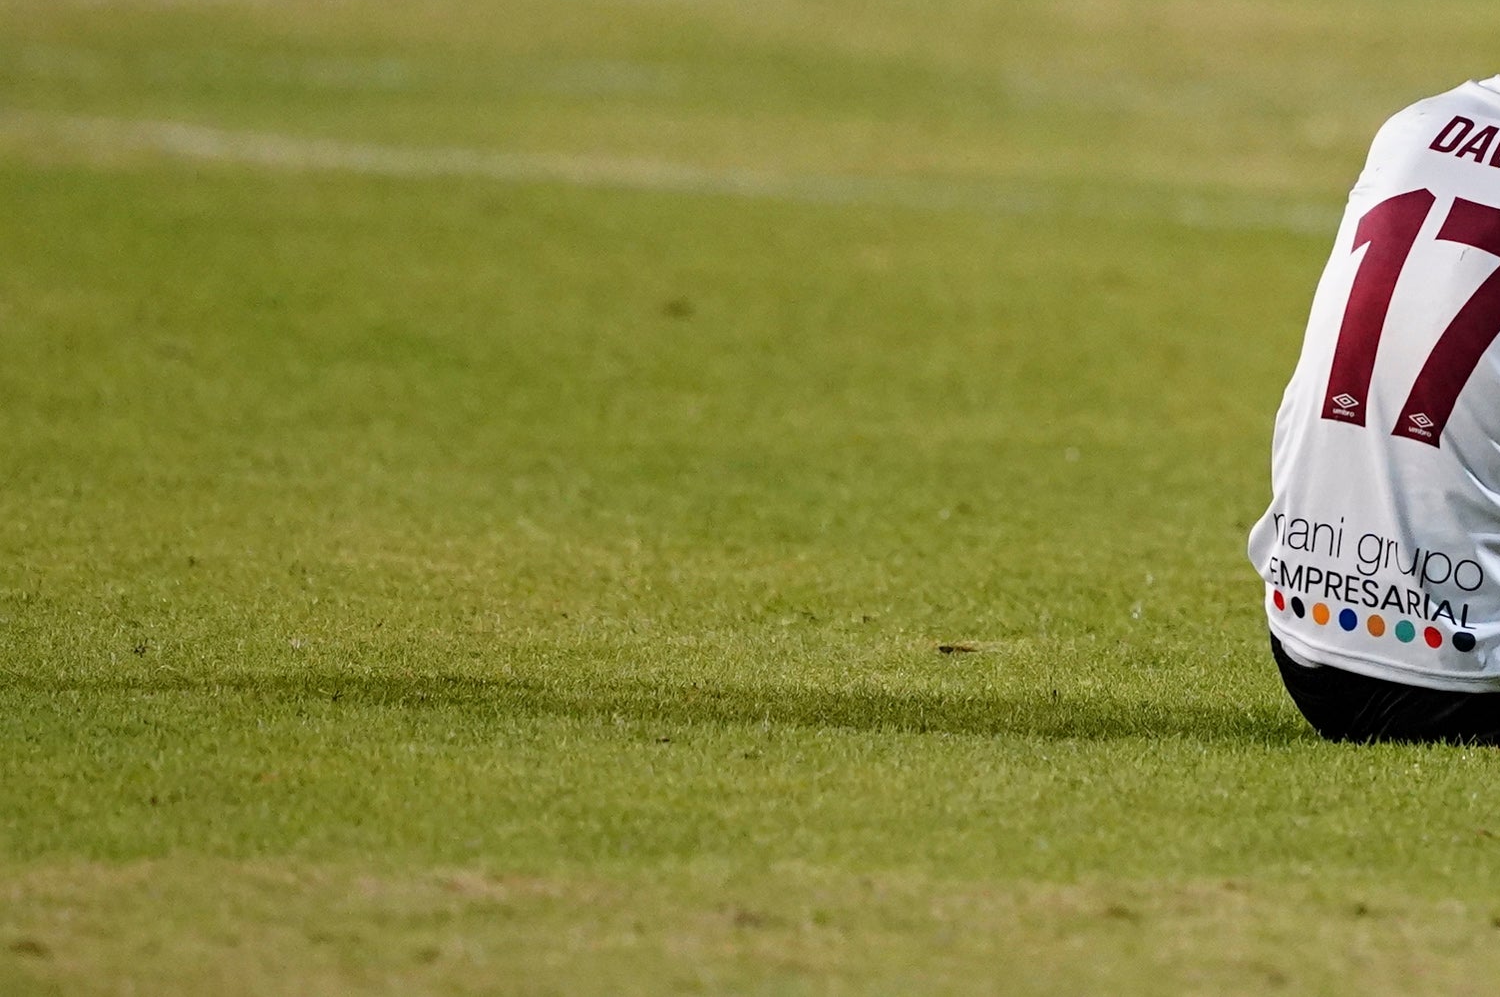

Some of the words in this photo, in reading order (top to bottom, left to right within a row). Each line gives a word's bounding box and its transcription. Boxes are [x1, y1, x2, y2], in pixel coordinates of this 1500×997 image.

[1332, 407, 1355, 418] umbro
[1408, 425, 1432, 438] umbro
[1356, 532, 1484, 592] grupo
[1269, 555, 1478, 630] EMPRESARIAL
